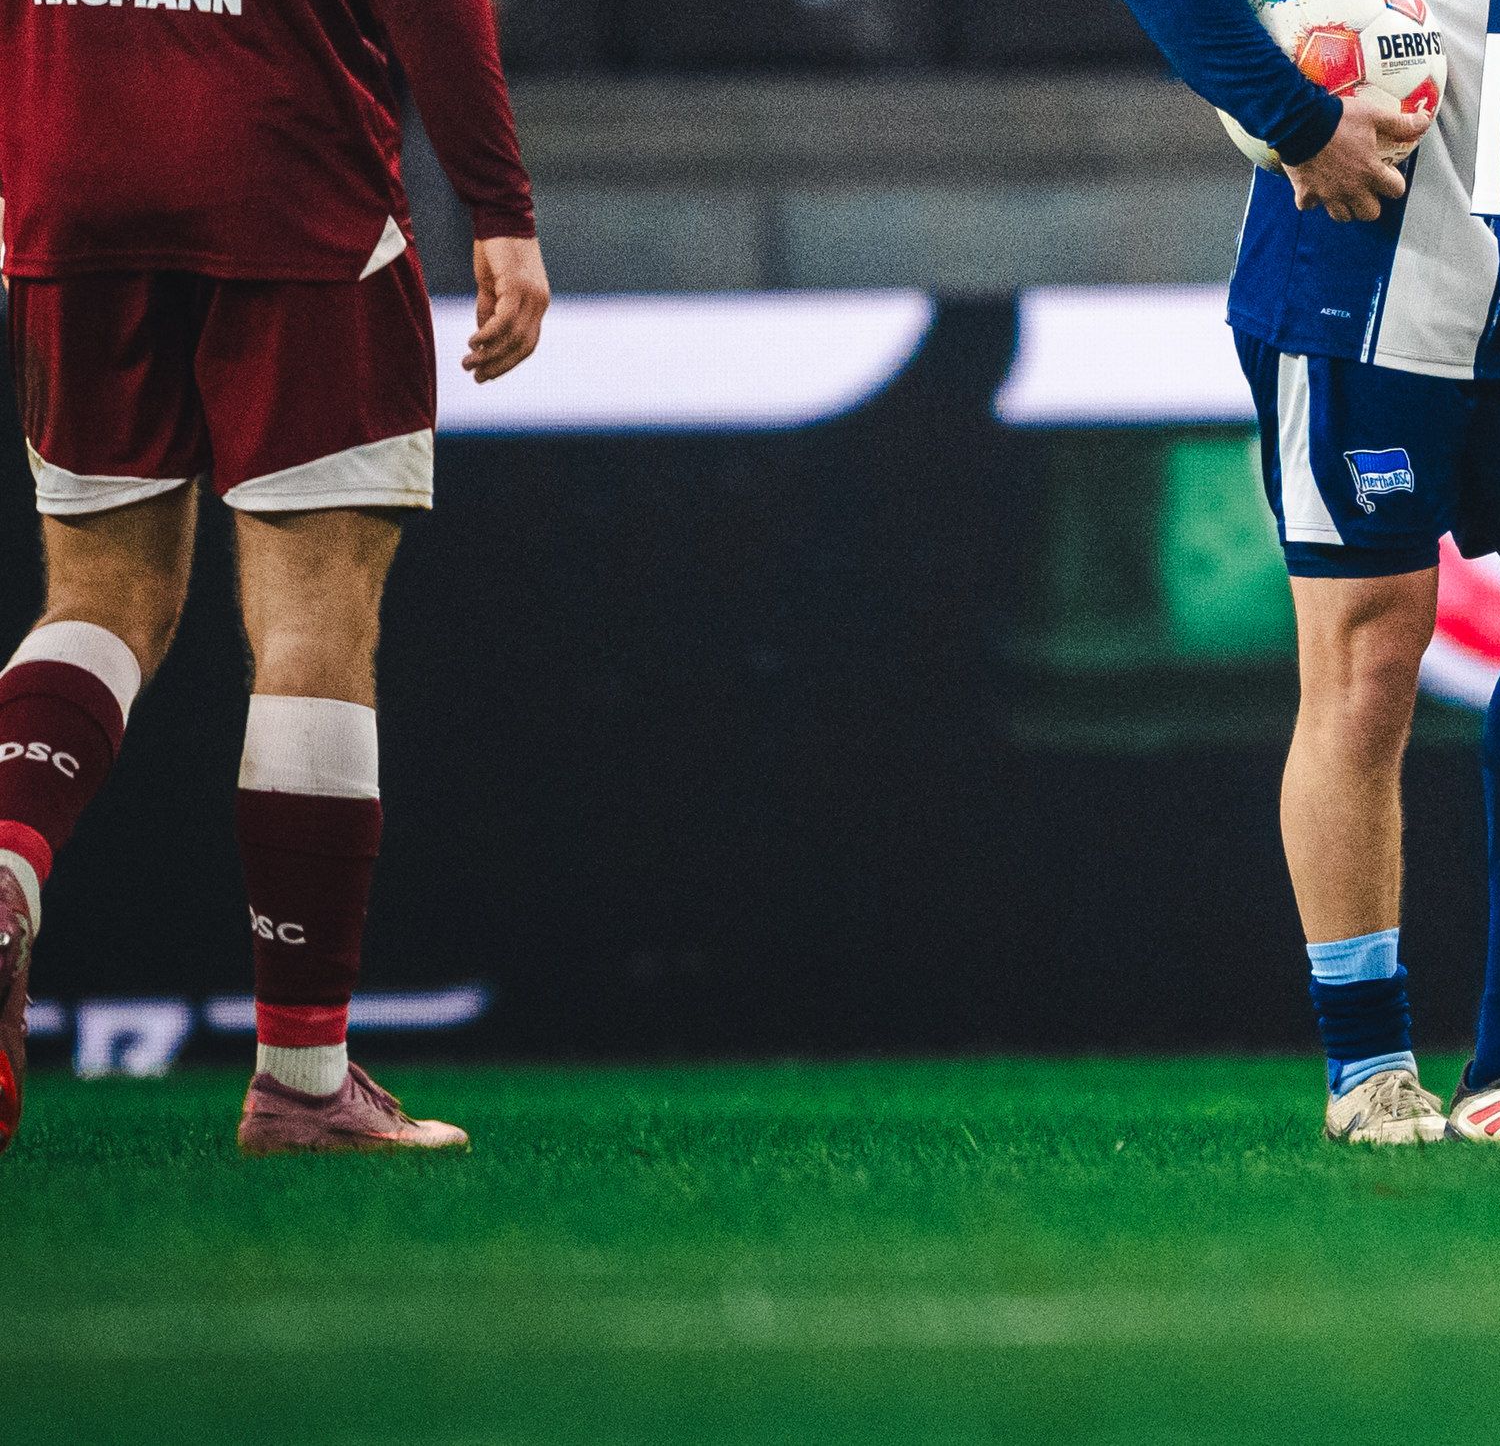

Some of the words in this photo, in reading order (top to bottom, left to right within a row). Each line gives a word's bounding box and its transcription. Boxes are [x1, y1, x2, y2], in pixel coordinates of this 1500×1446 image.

[1389, 58, 1427, 68] BUNDESLIGA
[1362, 474, 1394, 490] Hertha
[1393, 471, 1410, 486] BSC
